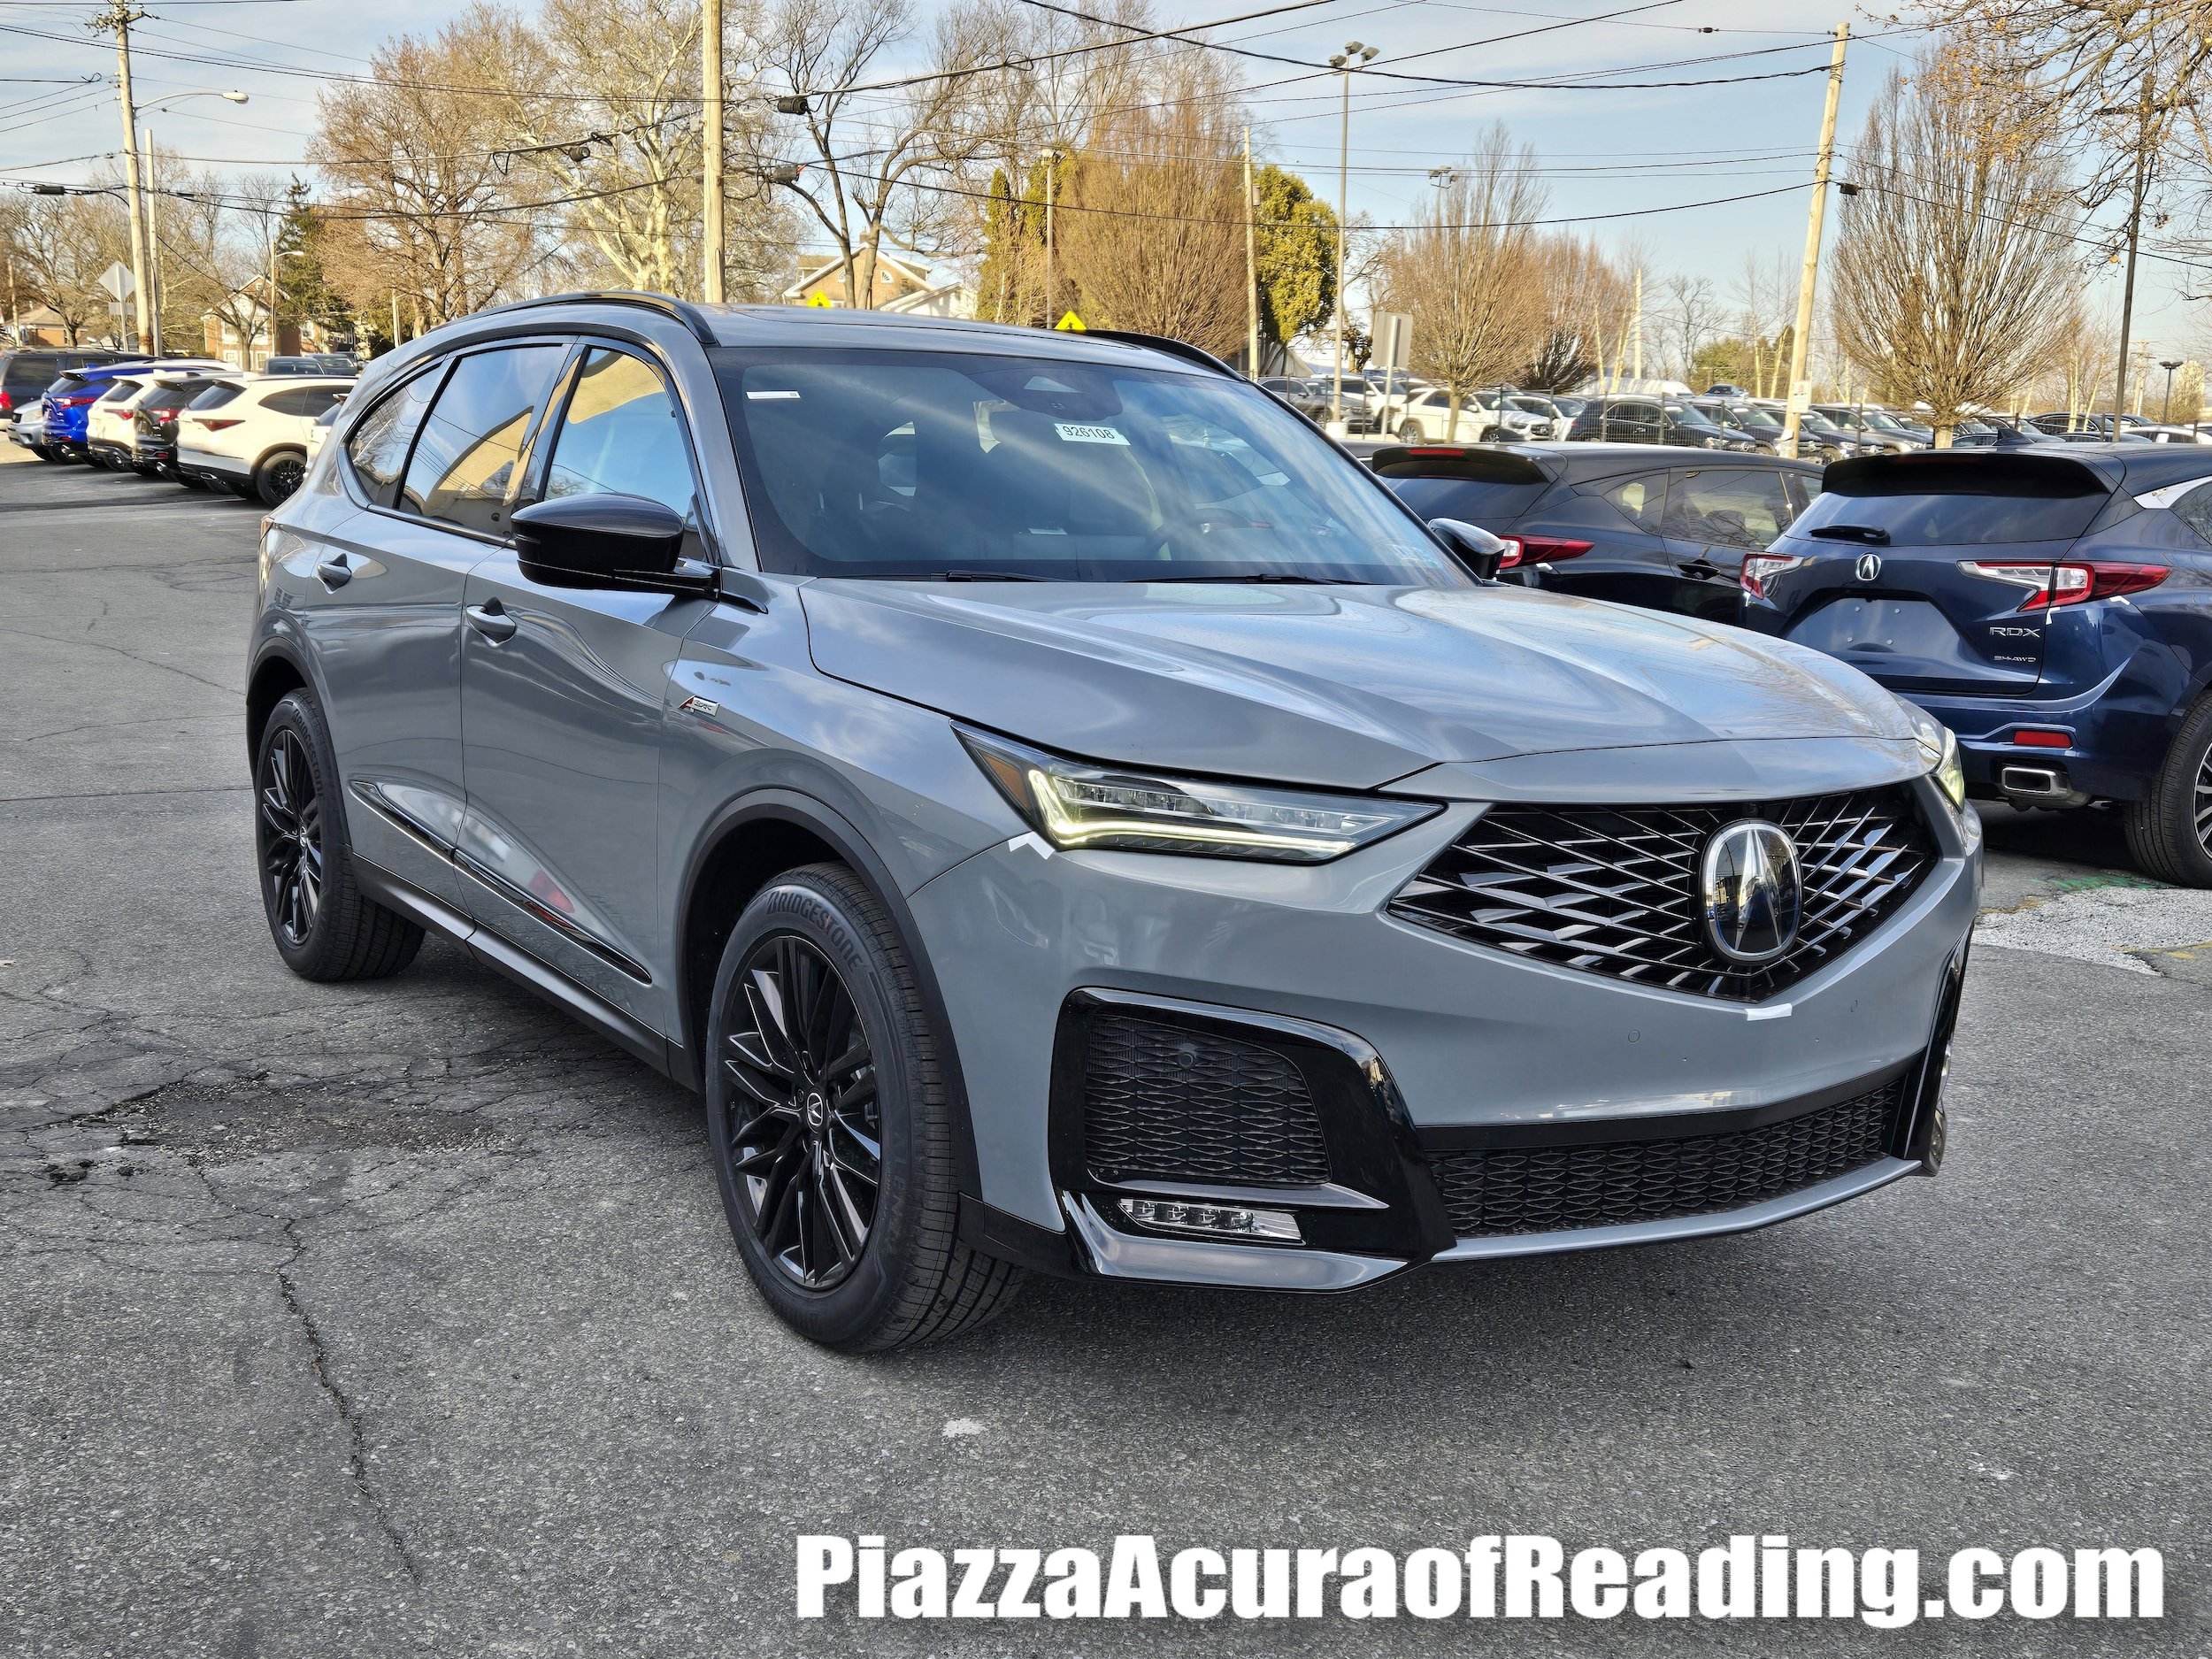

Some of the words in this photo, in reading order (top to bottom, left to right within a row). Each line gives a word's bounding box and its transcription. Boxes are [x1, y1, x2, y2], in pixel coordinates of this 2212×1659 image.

[1062, 426, 1116, 440] 926108
[1989, 626, 2041, 638] RDX
[766, 890, 864, 974] BRIDGESTONE
